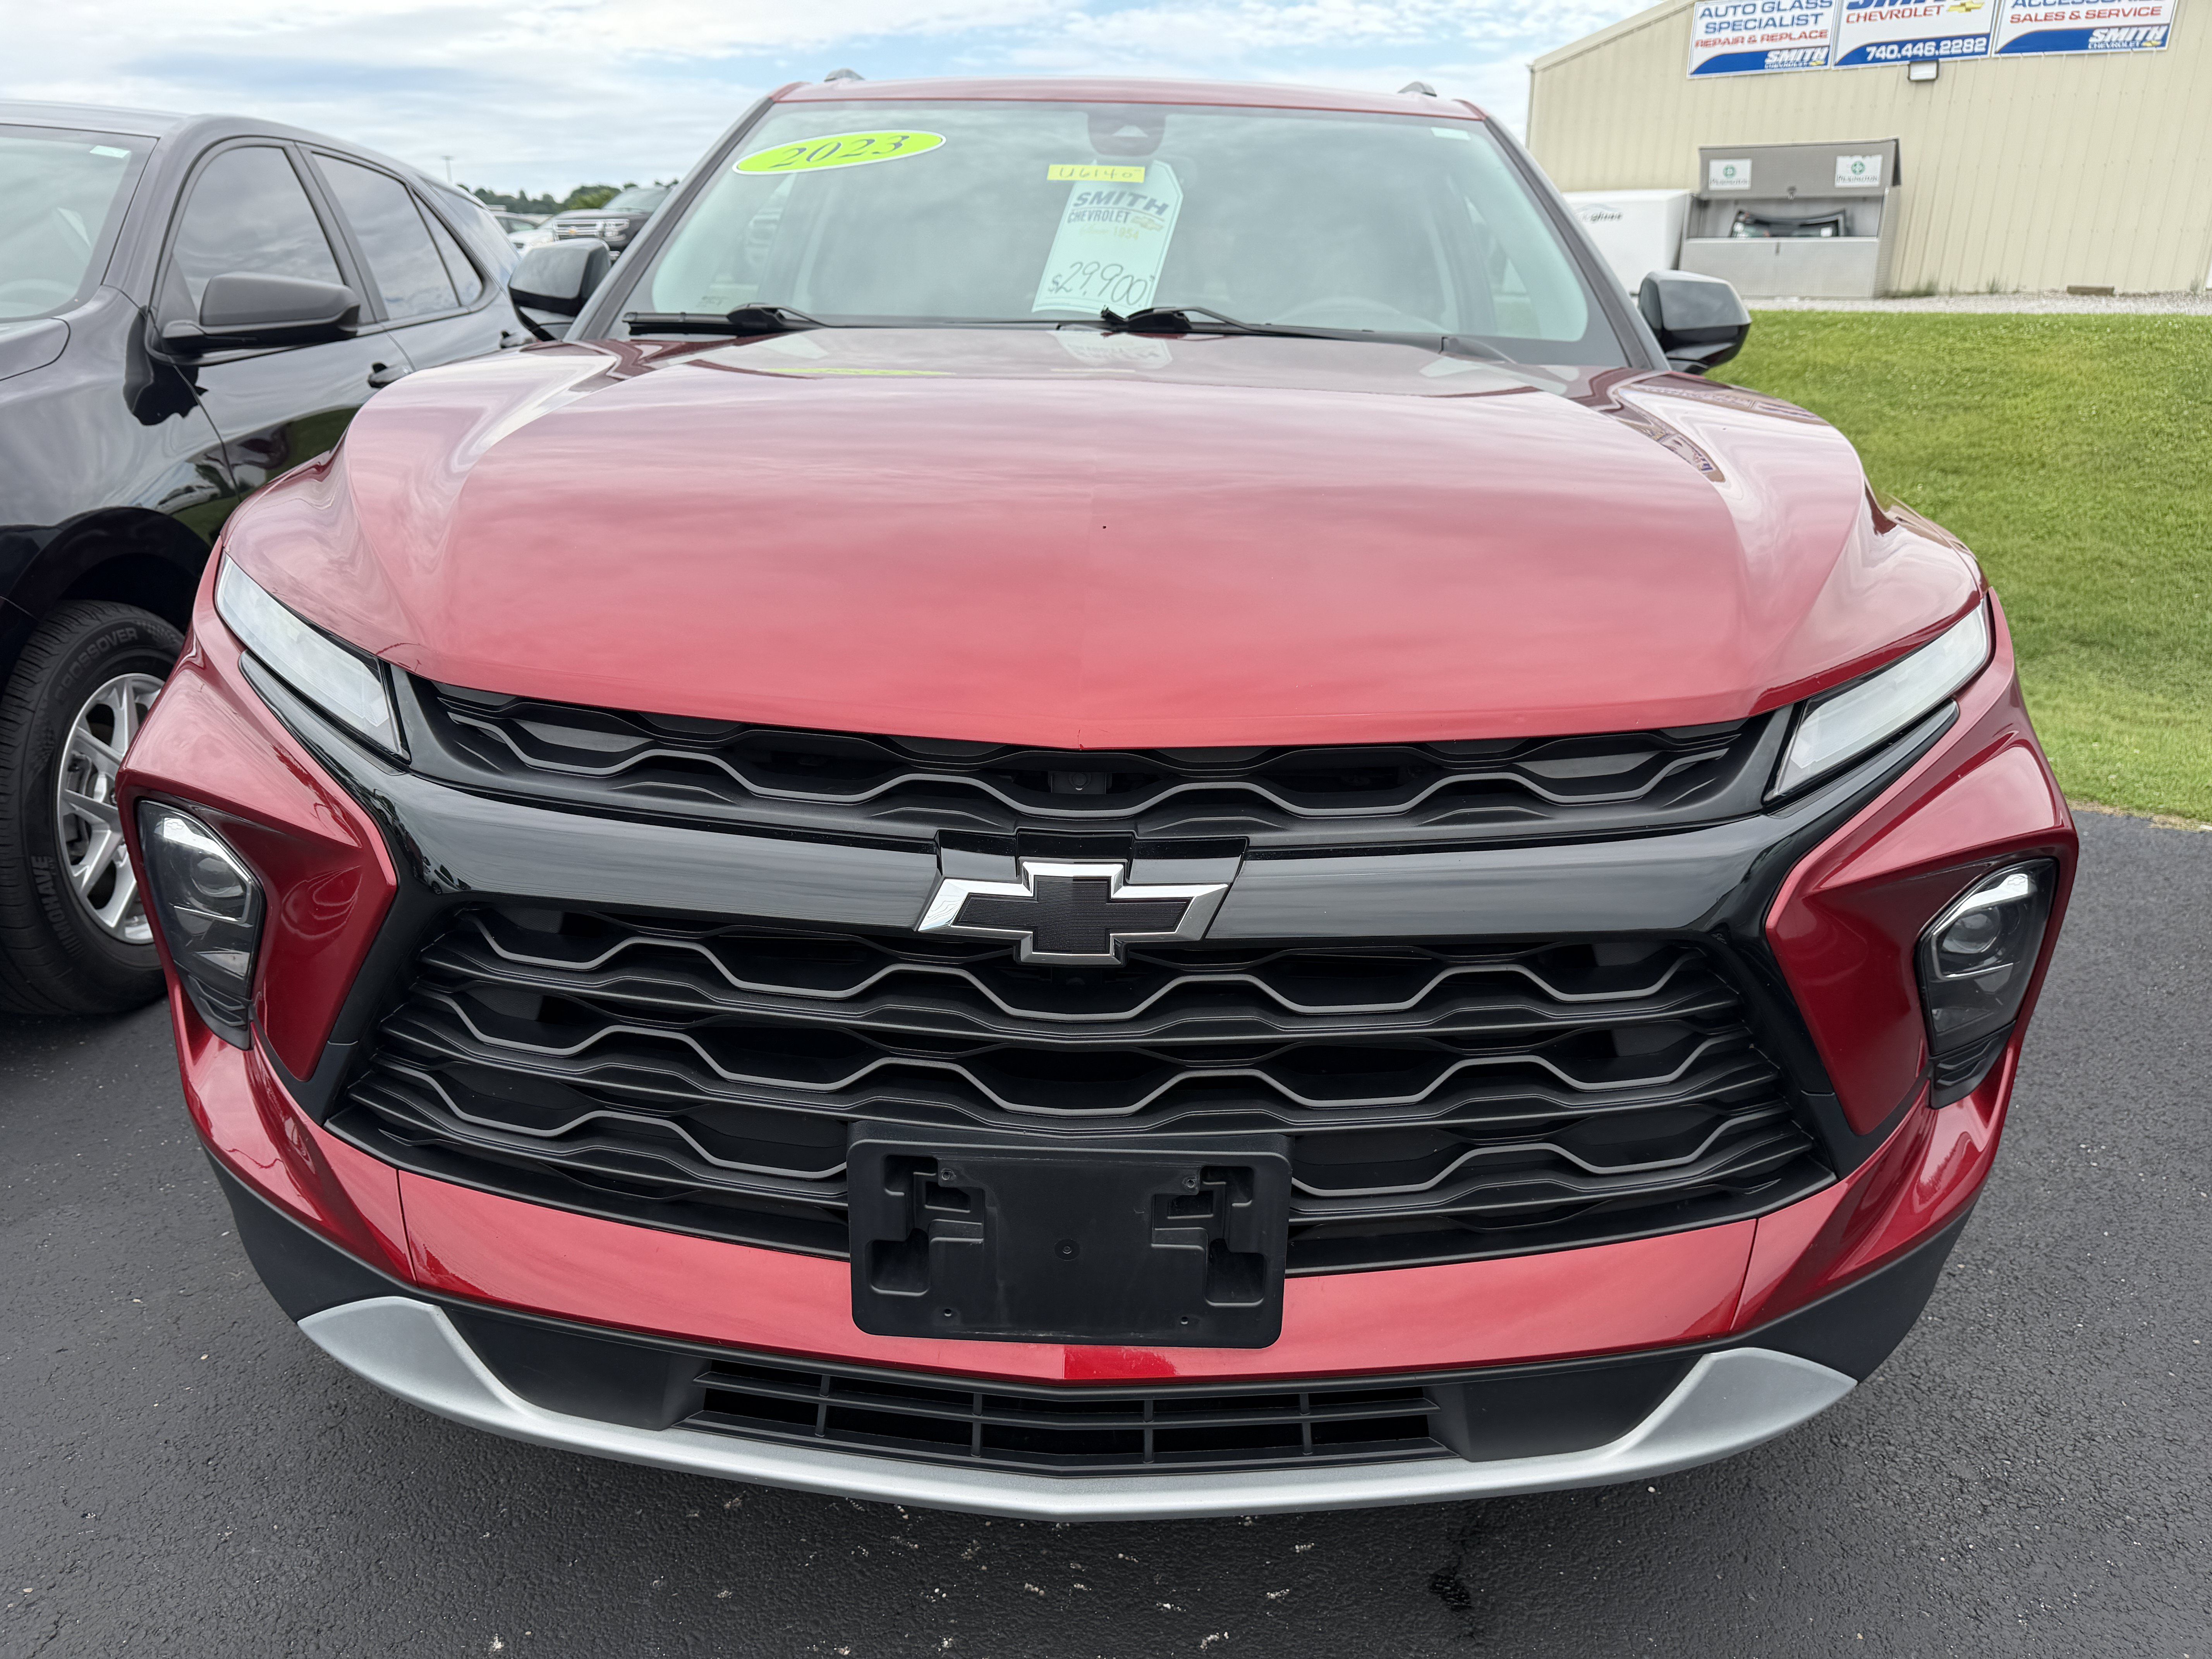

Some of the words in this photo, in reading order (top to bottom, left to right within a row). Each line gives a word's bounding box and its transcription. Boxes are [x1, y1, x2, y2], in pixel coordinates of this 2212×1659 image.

[1699, 3, 1756, 18] AUTO
[1762, 0, 1833, 13] GLASS
[1846, 5, 1944, 24] CHEVROLET
[2009, 11, 2066, 24] SALES
[2068, 10, 2081, 21] &
[2085, 6, 2162, 19] SERVICE
[1704, 13, 1823, 33] SPECIALIST
[1695, 35, 1744, 48] REPAIR
[1760, 29, 1828, 43] REPLACE
[2088, 25, 2168, 42] SMITH
[1765, 48, 1828, 62] SMITH
[1866, 37, 1987, 61] 740.446.2282
[768, 135, 910, 168] 2023
[1073, 191, 1169, 216] SMITH
[1067, 210, 1131, 223] CHEVROLET
